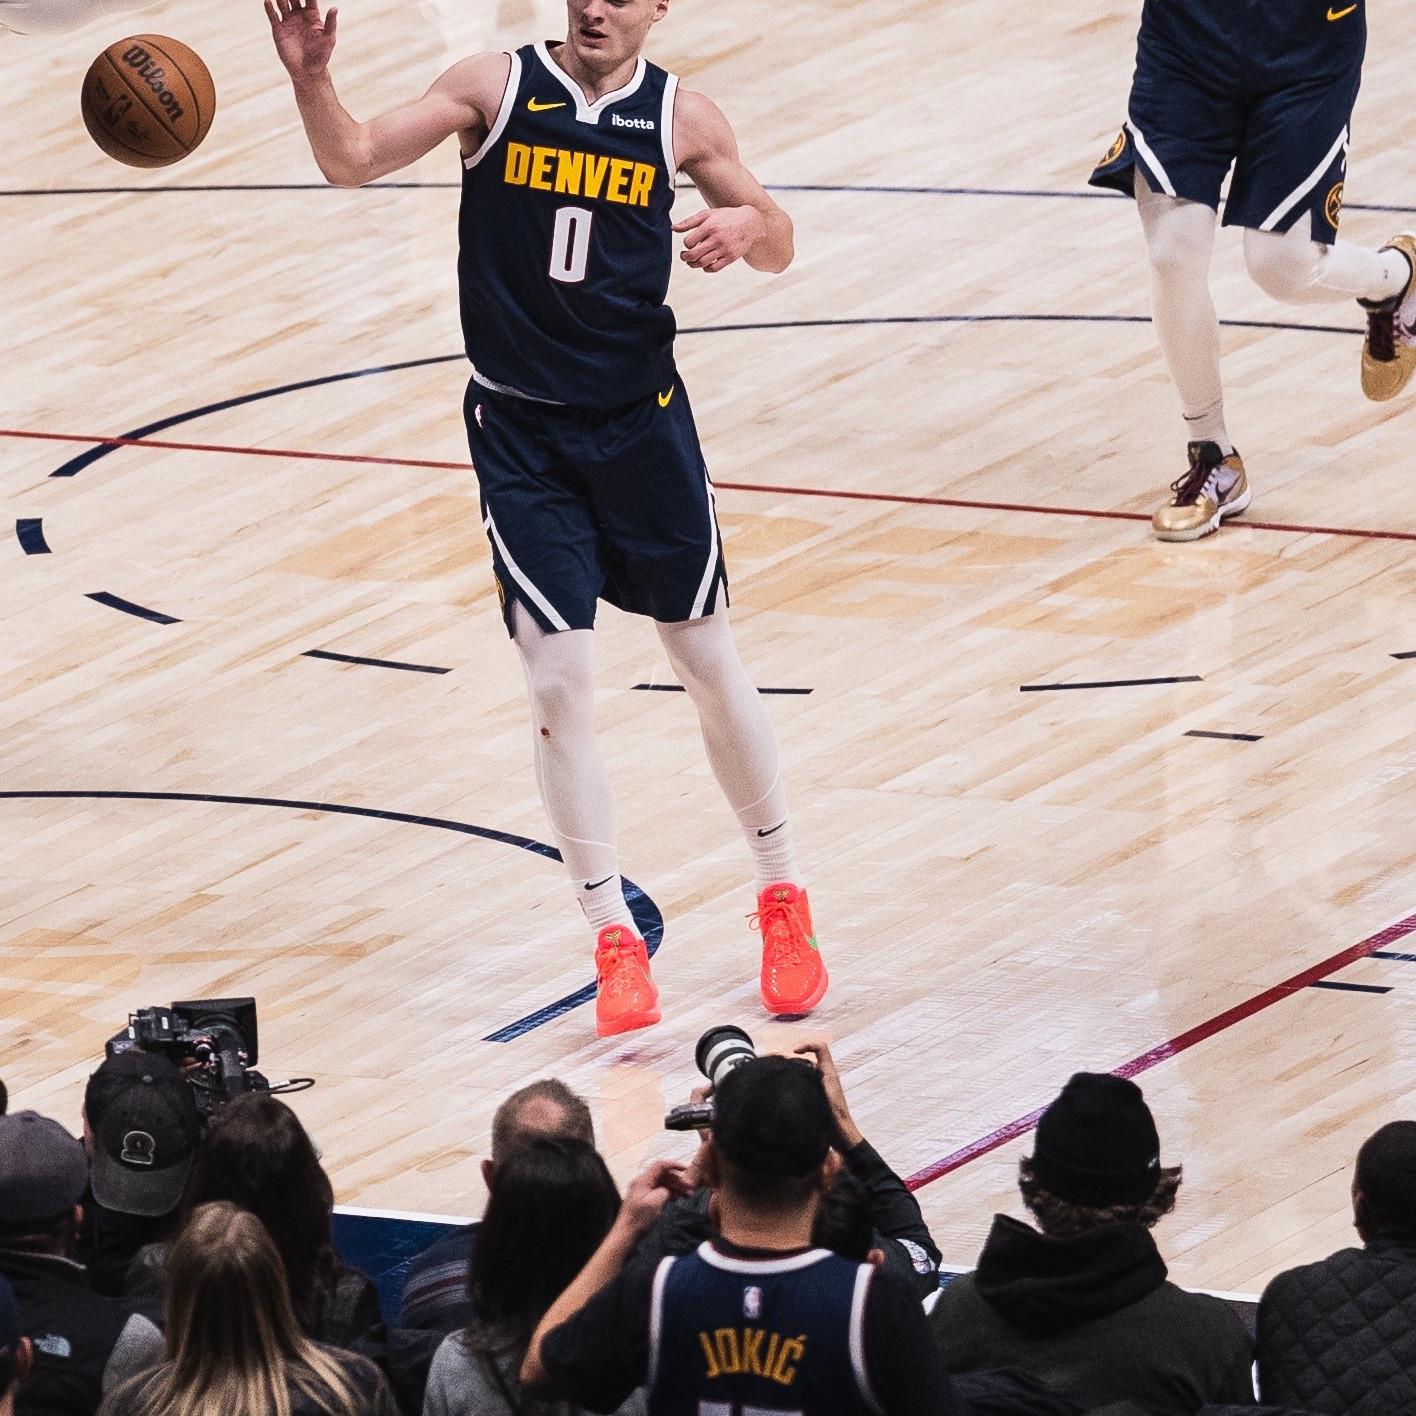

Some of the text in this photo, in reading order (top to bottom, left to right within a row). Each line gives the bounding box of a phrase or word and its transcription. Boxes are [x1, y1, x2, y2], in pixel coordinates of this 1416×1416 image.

[121, 44, 185, 123] Wilson
[611, 113, 655, 130] ibotta
[504, 141, 657, 208] DENVER
[548, 206, 594, 283] 0
[698, 1327, 807, 1385] JOKIĆ
